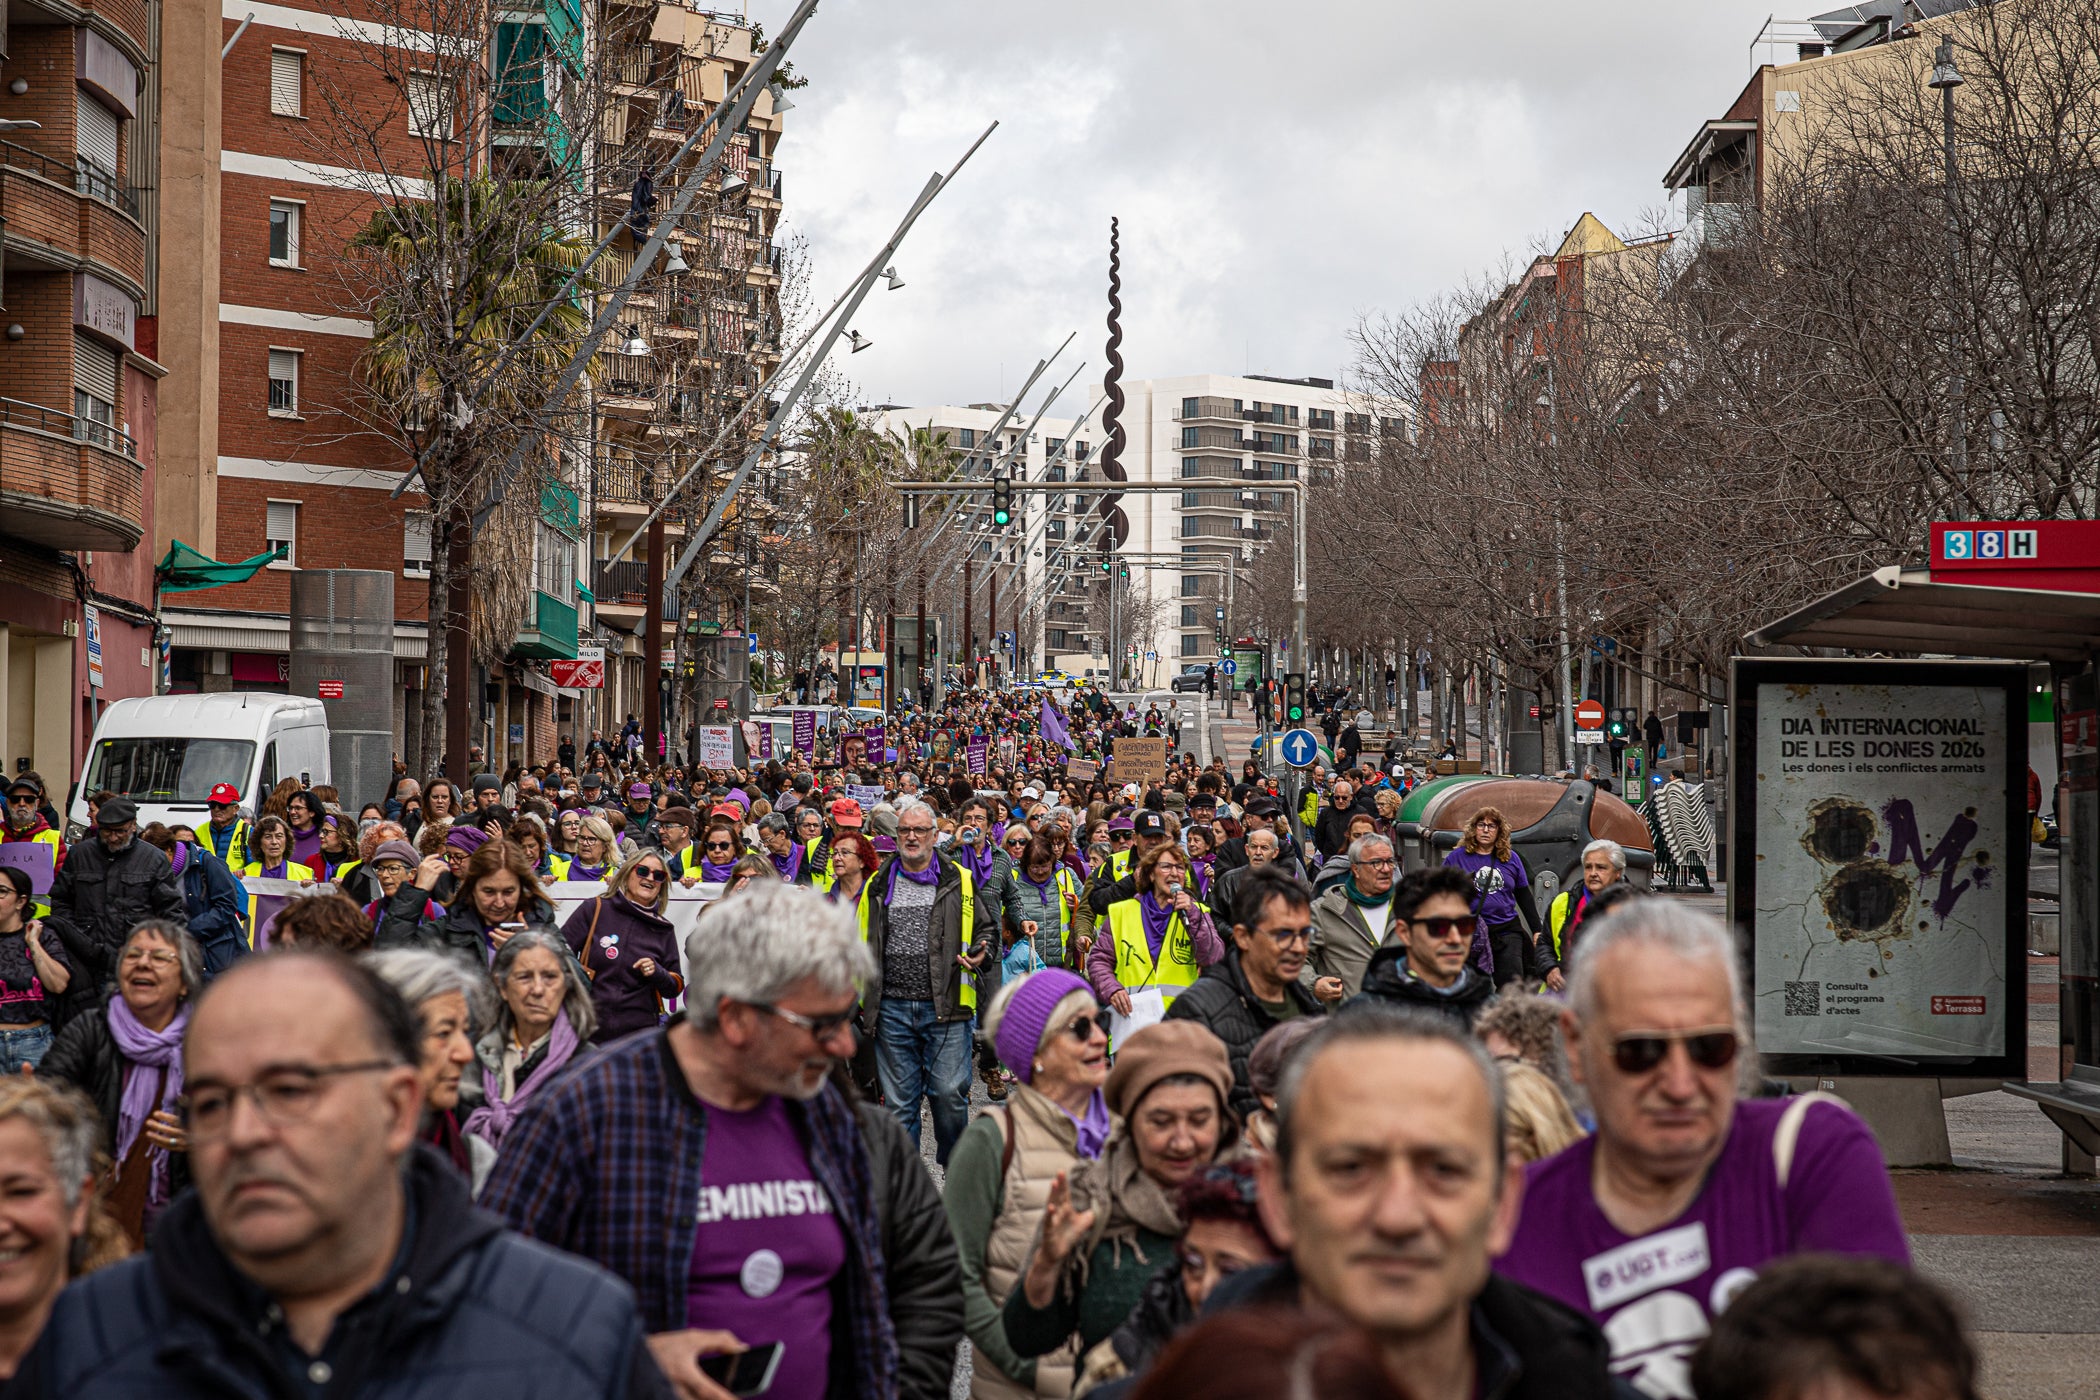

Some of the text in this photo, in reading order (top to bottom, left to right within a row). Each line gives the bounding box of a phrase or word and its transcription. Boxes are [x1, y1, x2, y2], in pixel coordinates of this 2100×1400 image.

[1949, 532, 2031, 558] 3 8 H
[1781, 718, 1985, 735] DIA INTERNACIONAL
[1781, 741, 1985, 758] DE LES DONES 2026
[1782, 763, 1985, 773] Les dones i els conflictes armats
[1826, 982, 1868, 991] Consulta
[1826, 995, 1885, 1006] el programa
[1826, 1006, 1860, 1015] d'actes
[1945, 1004, 1982, 1013] Terrassa
[697, 1179, 833, 1223] EMINISTA
